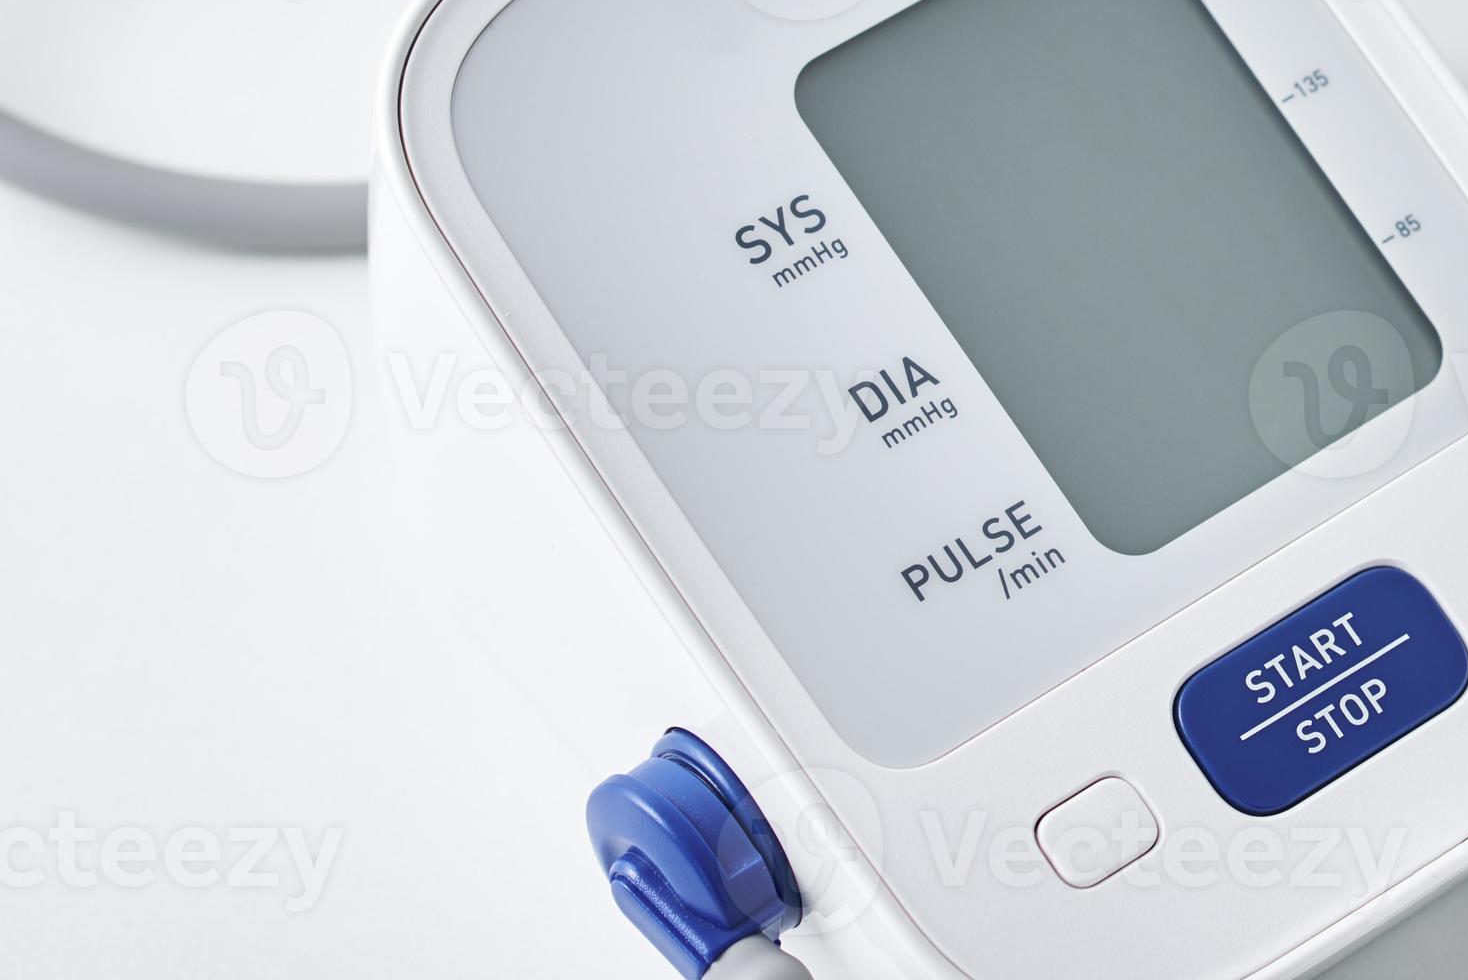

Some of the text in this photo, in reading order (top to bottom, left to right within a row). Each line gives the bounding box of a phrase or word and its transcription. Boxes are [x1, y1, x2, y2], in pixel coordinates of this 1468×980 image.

[735, 194, 826, 264] SYS
[772, 238, 848, 287] mmHg
[848, 356, 940, 423] DIA
[881, 397, 958, 448] mmHg
[901, 499, 1043, 602] PULSE
[997, 548, 1066, 600] /min
[1245, 611, 1362, 704] START
[1296, 678, 1387, 754] STOP
